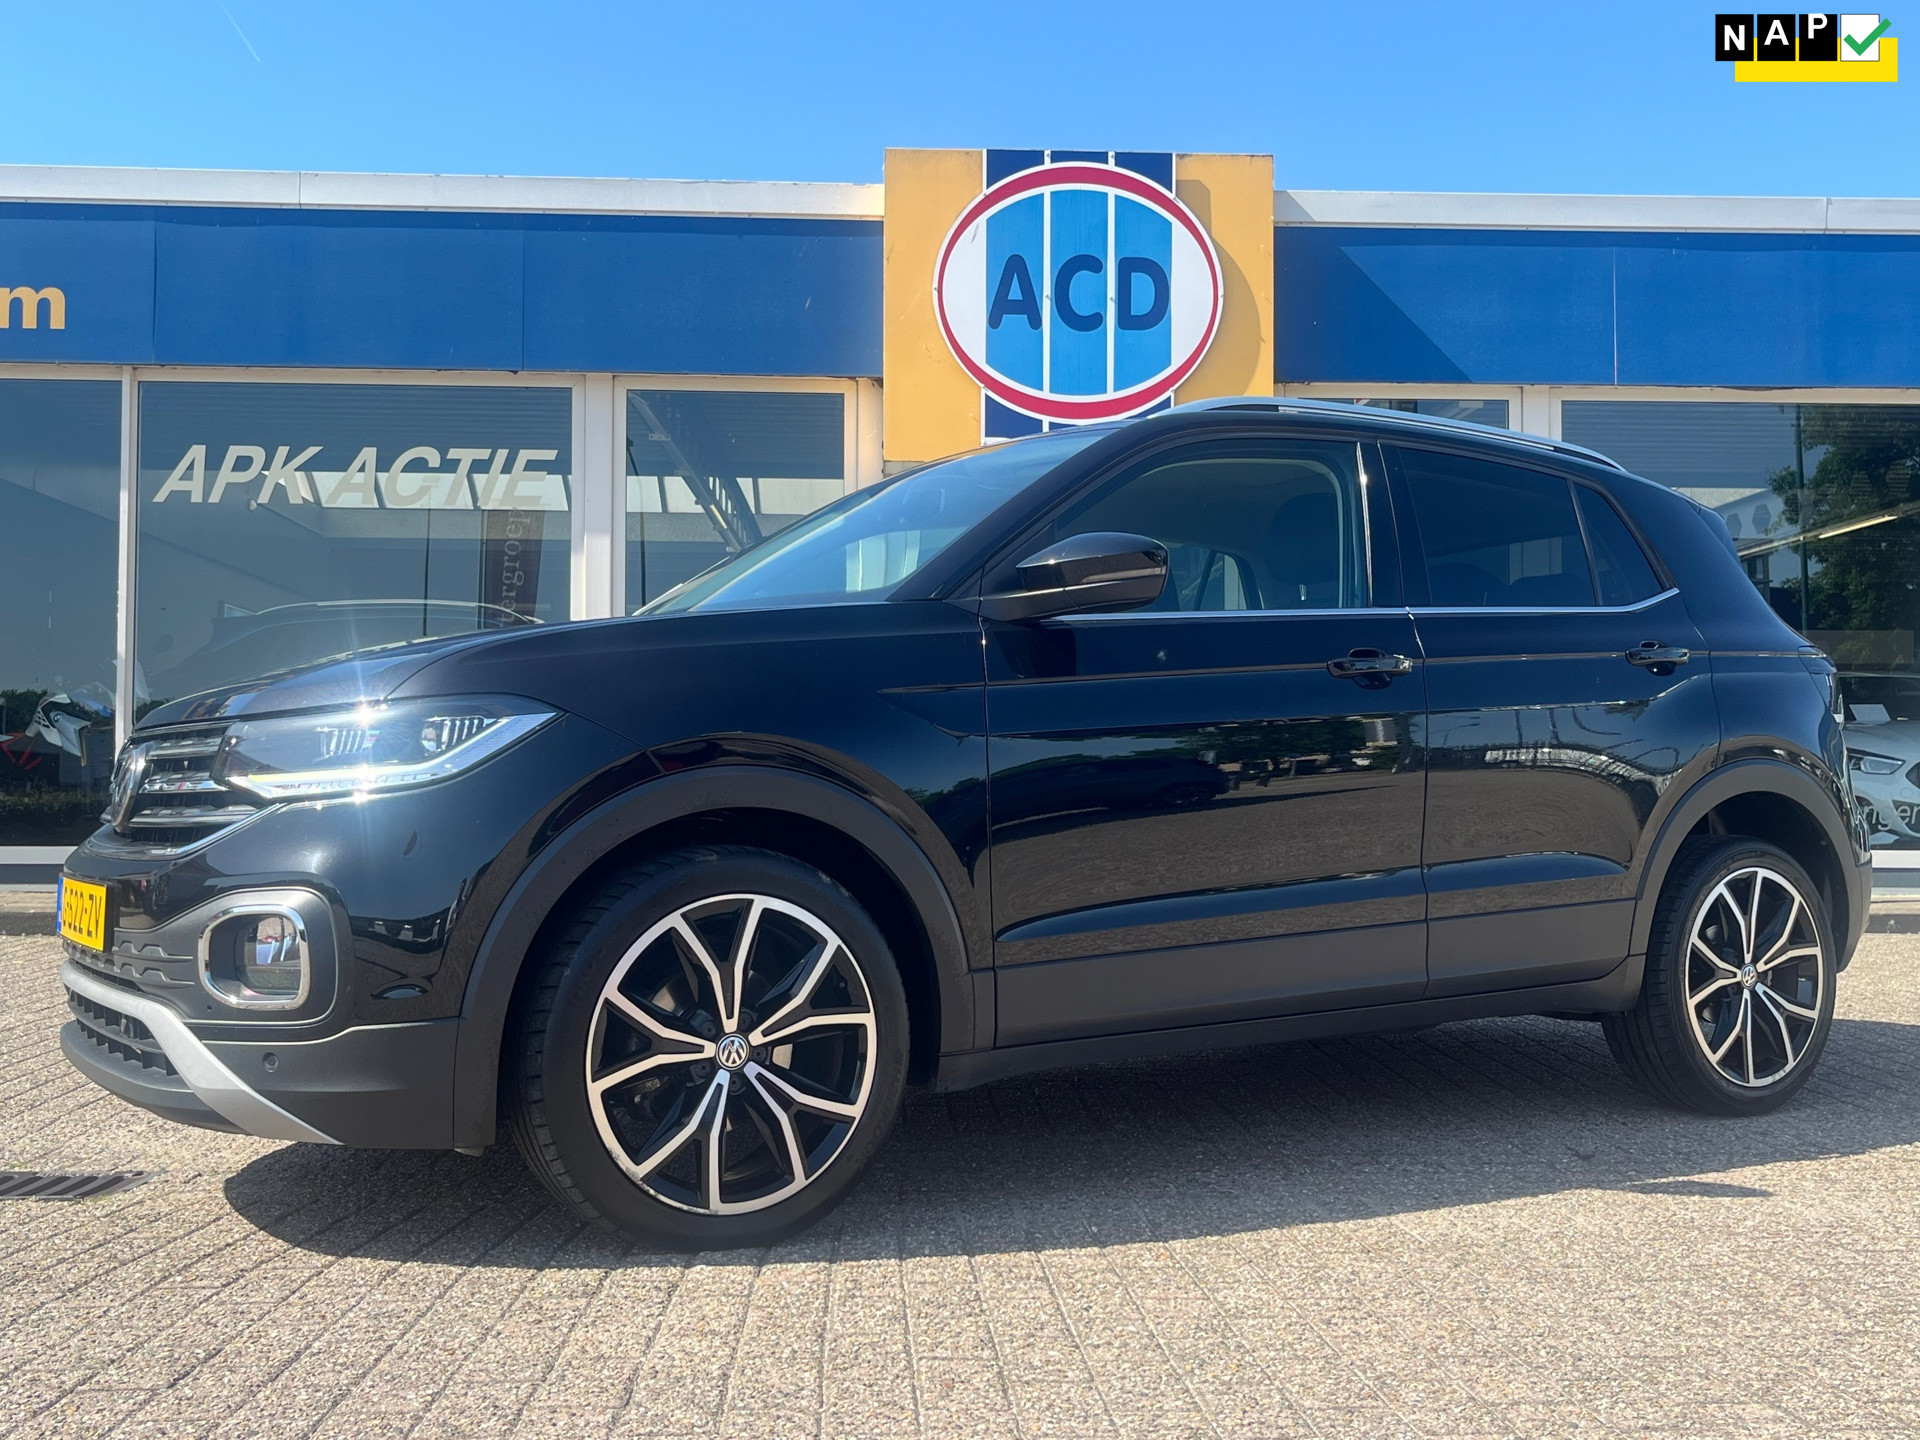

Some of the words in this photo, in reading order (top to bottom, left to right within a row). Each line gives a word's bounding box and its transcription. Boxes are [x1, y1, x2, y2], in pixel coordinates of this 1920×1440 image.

[988, 253, 1170, 333] ACD
[153, 444, 324, 505] APK
[324, 446, 559, 508] ACTIE
